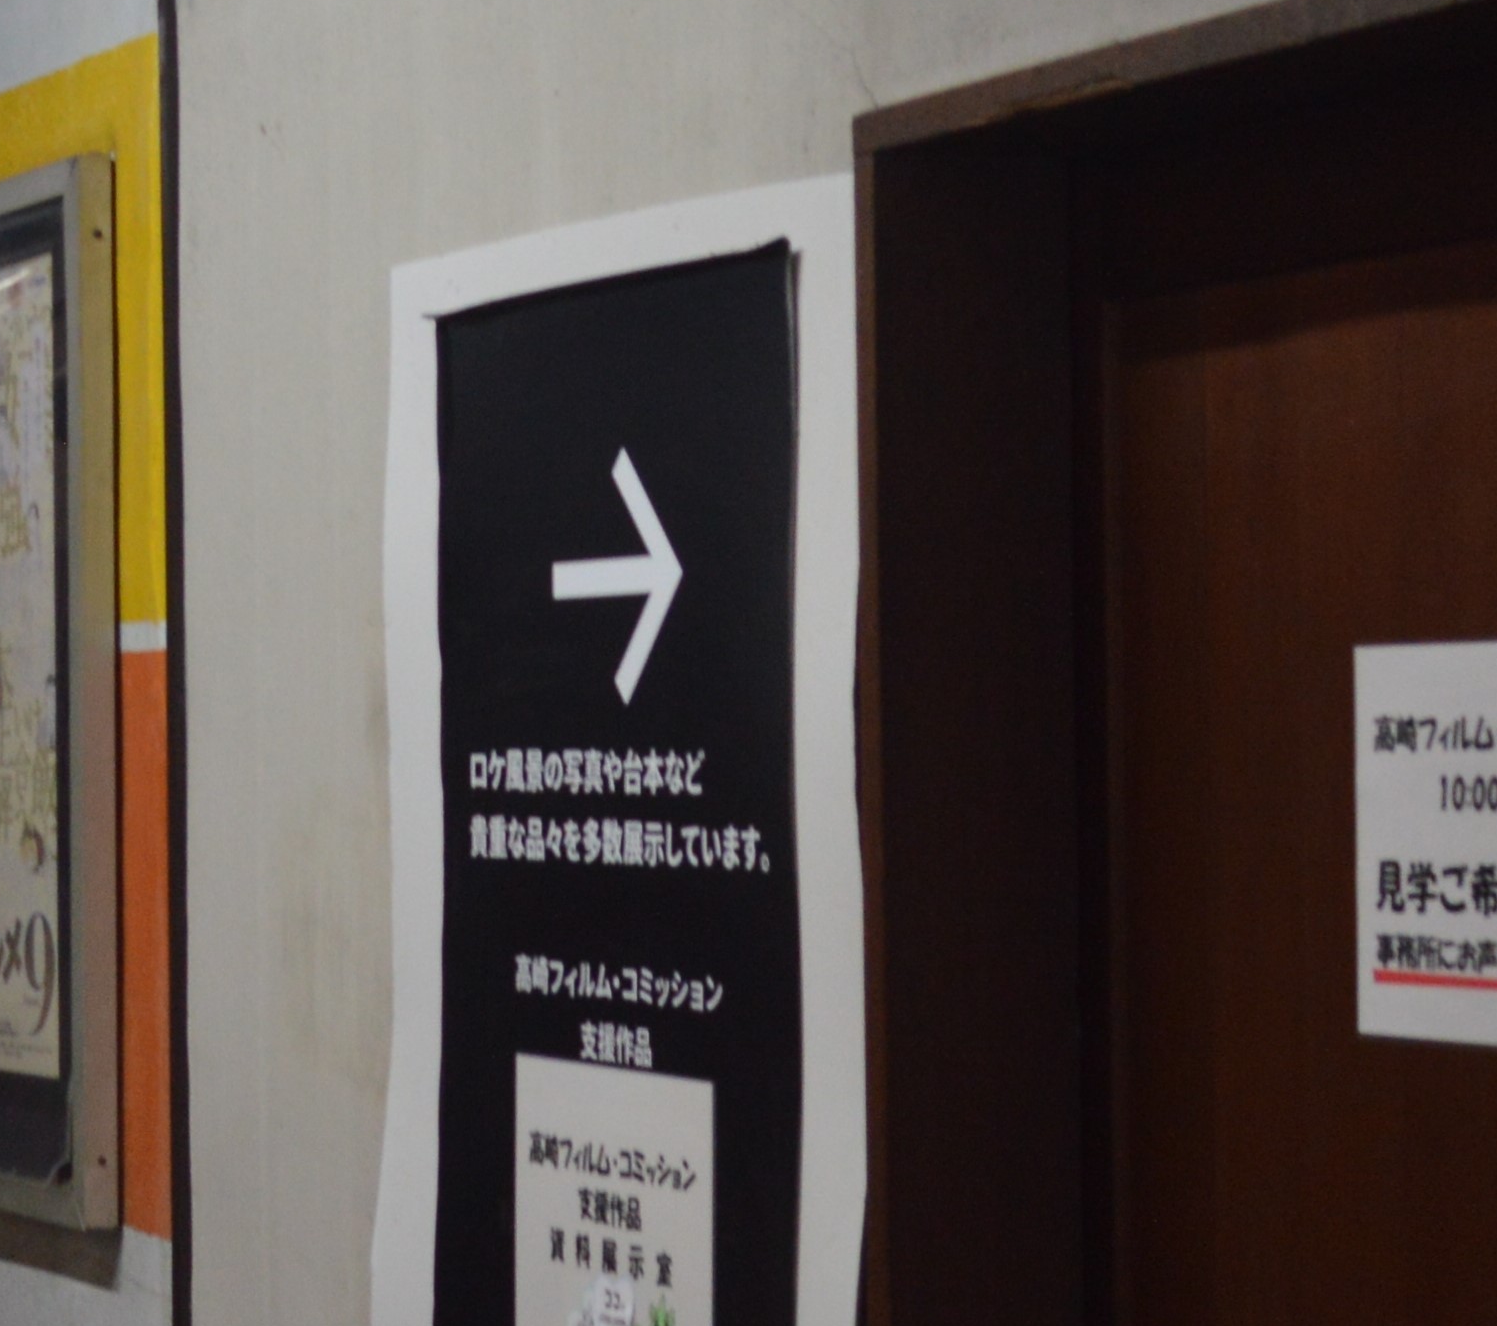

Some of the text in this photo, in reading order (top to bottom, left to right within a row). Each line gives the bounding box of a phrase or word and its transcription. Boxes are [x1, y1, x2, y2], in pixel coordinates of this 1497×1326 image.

[469, 747, 705, 796] ロケ風景の写真や台本など
[469, 813, 770, 873] 貴重な品々を多数展示しています。
[515, 953, 723, 1013] 高崎フィルム・コミッション
[580, 1020, 653, 1068] 支援作品
[578, 1187, 642, 1232] 支援作品
